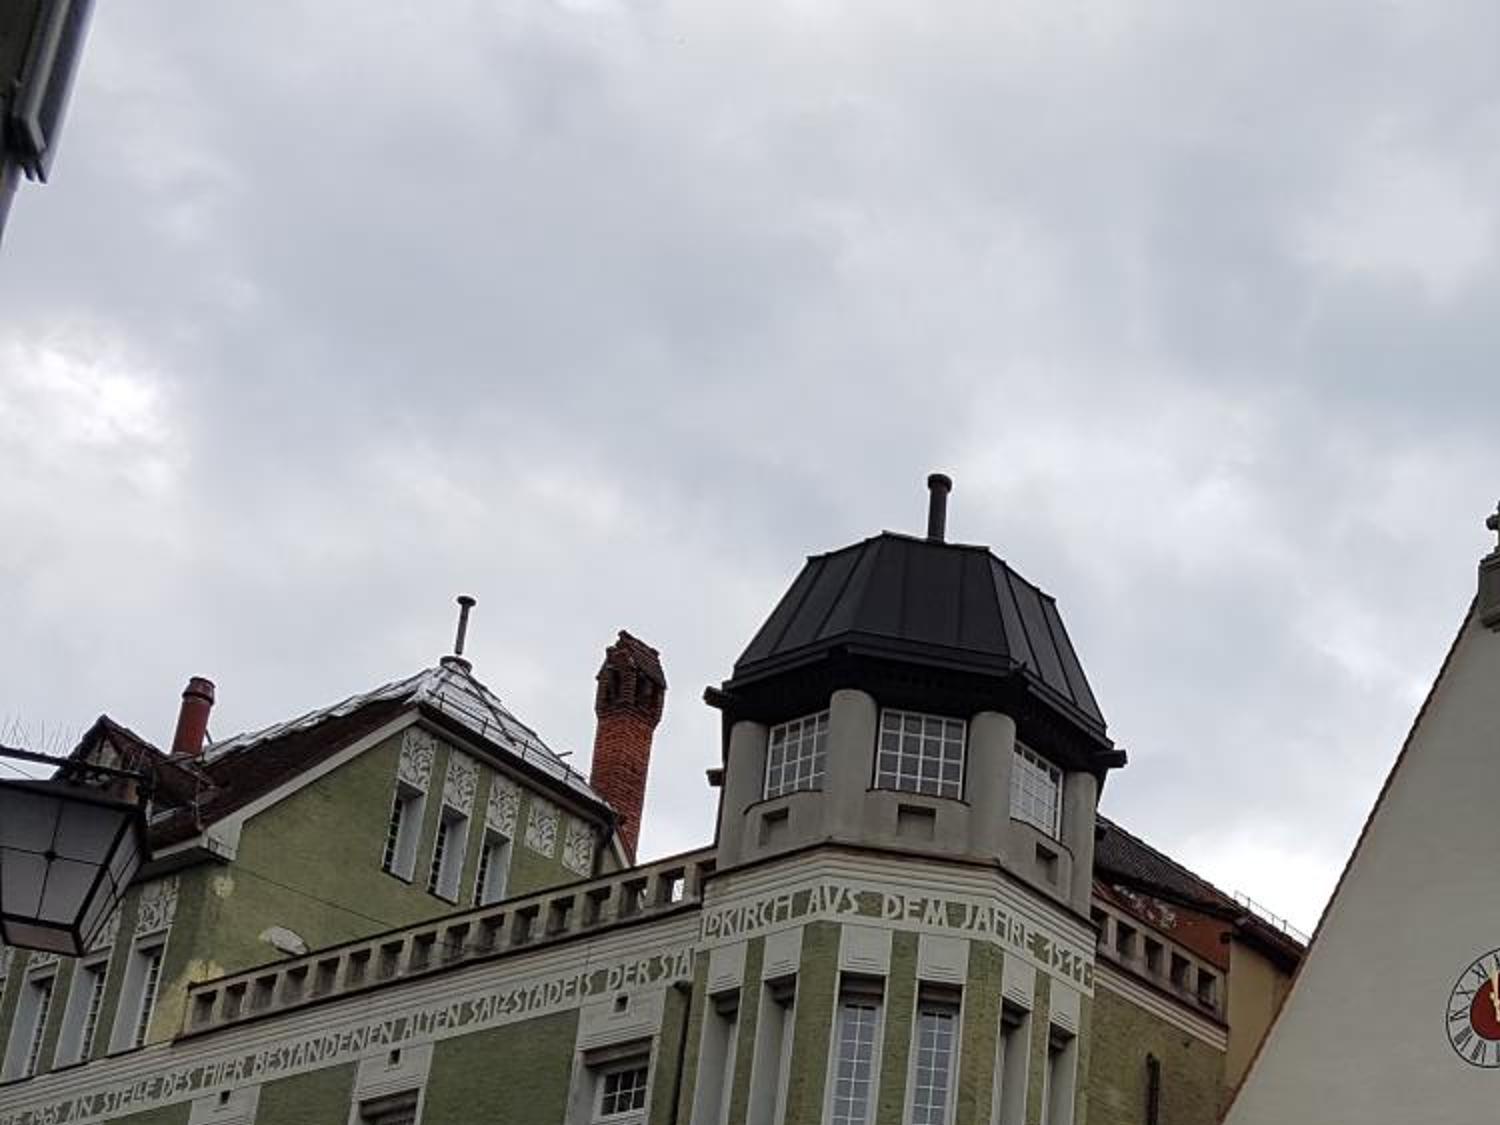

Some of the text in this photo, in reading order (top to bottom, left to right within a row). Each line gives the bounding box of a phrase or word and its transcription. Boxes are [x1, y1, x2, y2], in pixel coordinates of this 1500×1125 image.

[882, 894, 949, 929] DEM
[961, 902, 1034, 953] JAHRE
[67, 1094, 95, 1122] AN
[102, 1077, 161, 1113] STELLE
[162, 1068, 195, 1101] DES
[201, 1057, 245, 1088] HIER
[252, 1020, 395, 1076] BESTANDENEN
[402, 1001, 462, 1040] ALTEN
[607, 959, 650, 990] DER
